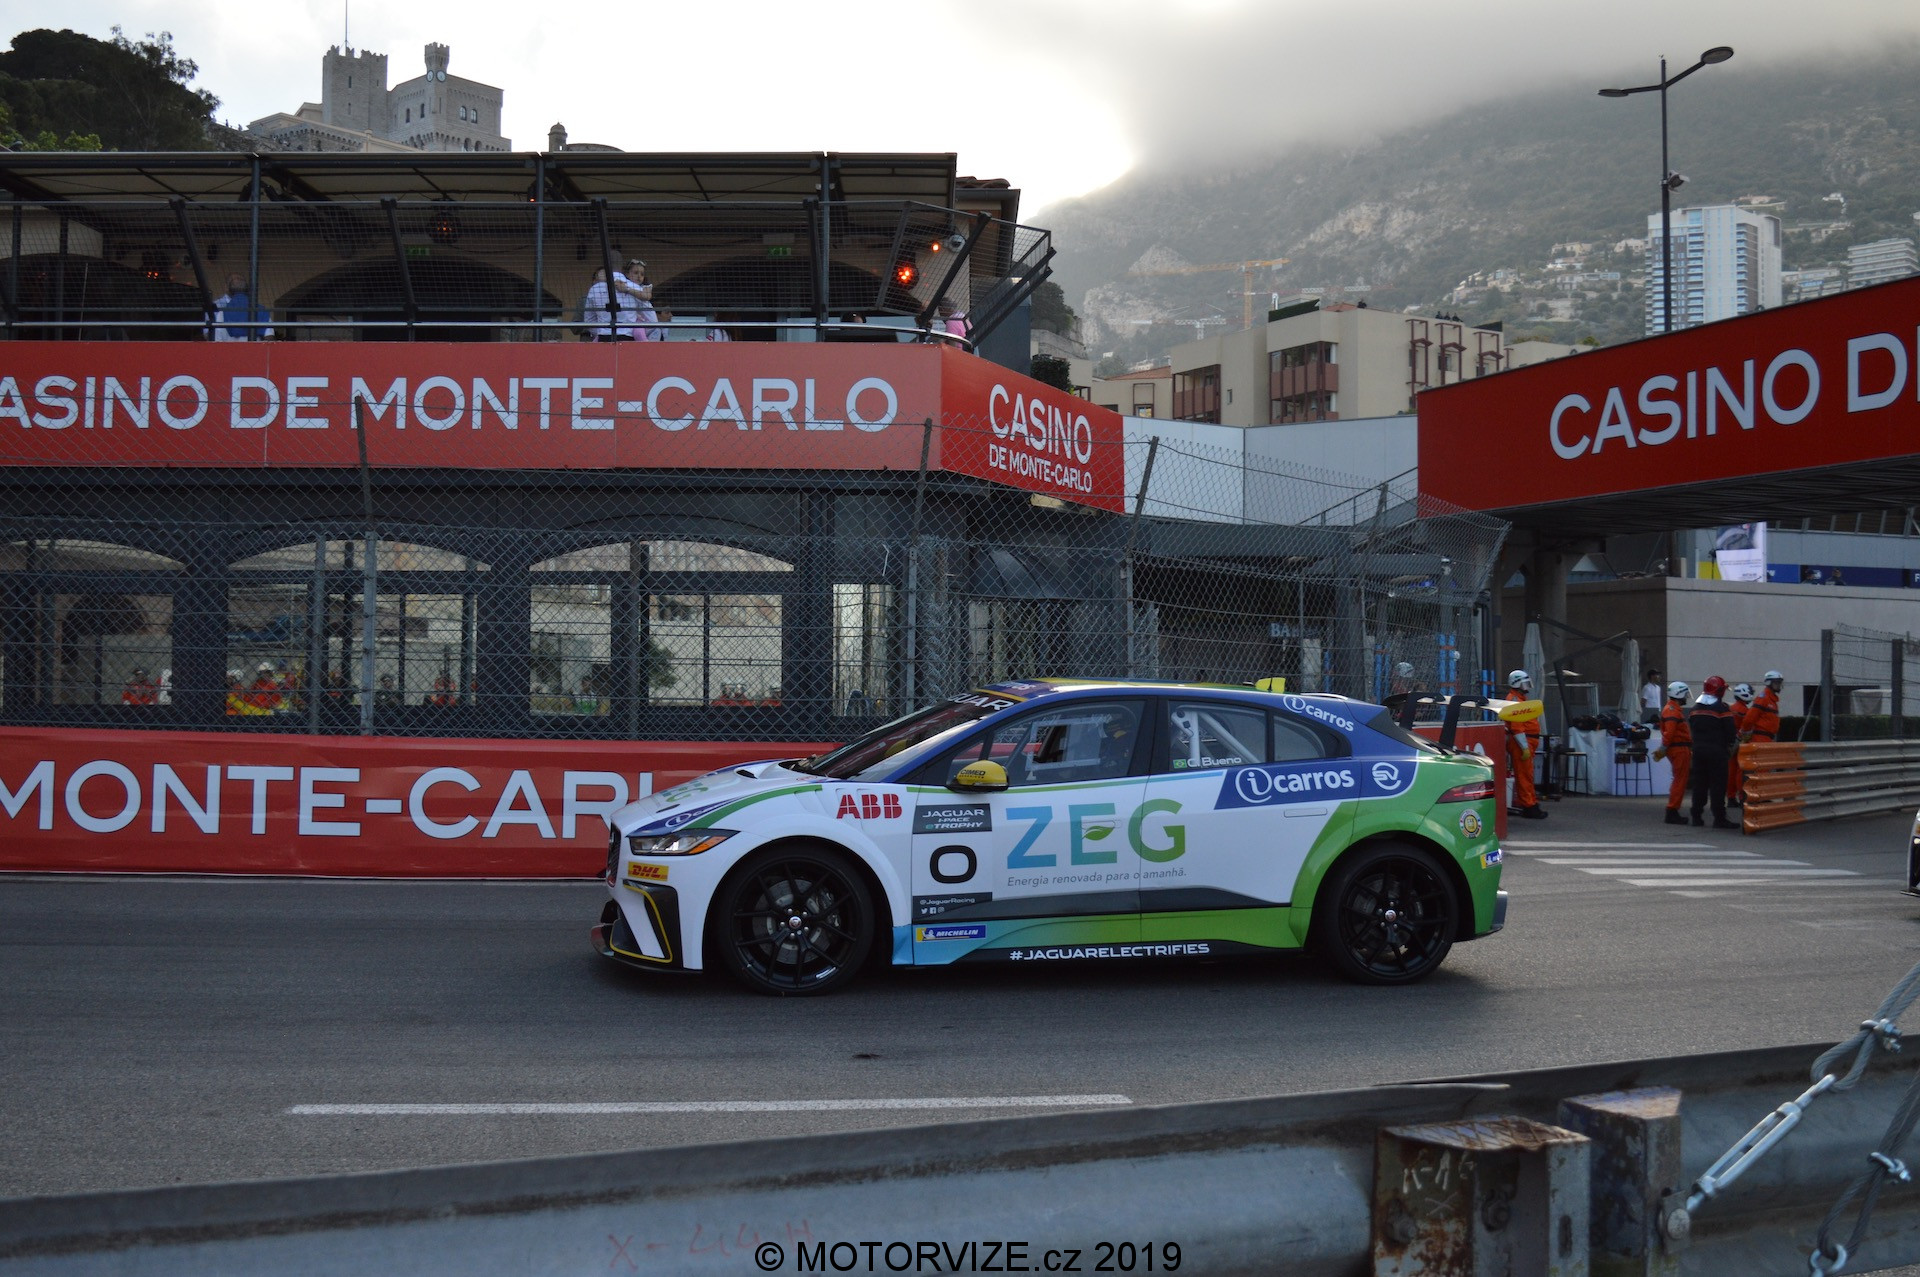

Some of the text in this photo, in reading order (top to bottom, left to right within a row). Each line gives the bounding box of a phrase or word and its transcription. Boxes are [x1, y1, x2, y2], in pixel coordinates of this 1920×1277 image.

[230, 376, 330, 430] DE
[350, 375, 898, 432] MONTE-CARLO
[1549, 326, 1920, 460] CASINO D
[989, 383, 1093, 465] CASINO
[989, 443, 1093, 493] DE MONTE-CARLO
[1201, 756, 1242, 767] Bueno
[836, 793, 903, 820] ABB
[922, 808, 985, 818] JAGUAR
[1005, 798, 1186, 870] ZEG
[631, 864, 662, 879] DHL
[1007, 867, 1188, 888] Energia renovada para o amanhã.
[919, 897, 976, 906] @JaguarRacing
[935, 928, 979, 937] MICHELIN
[1009, 943, 1211, 961] #JAGUARELECTRIFIES
